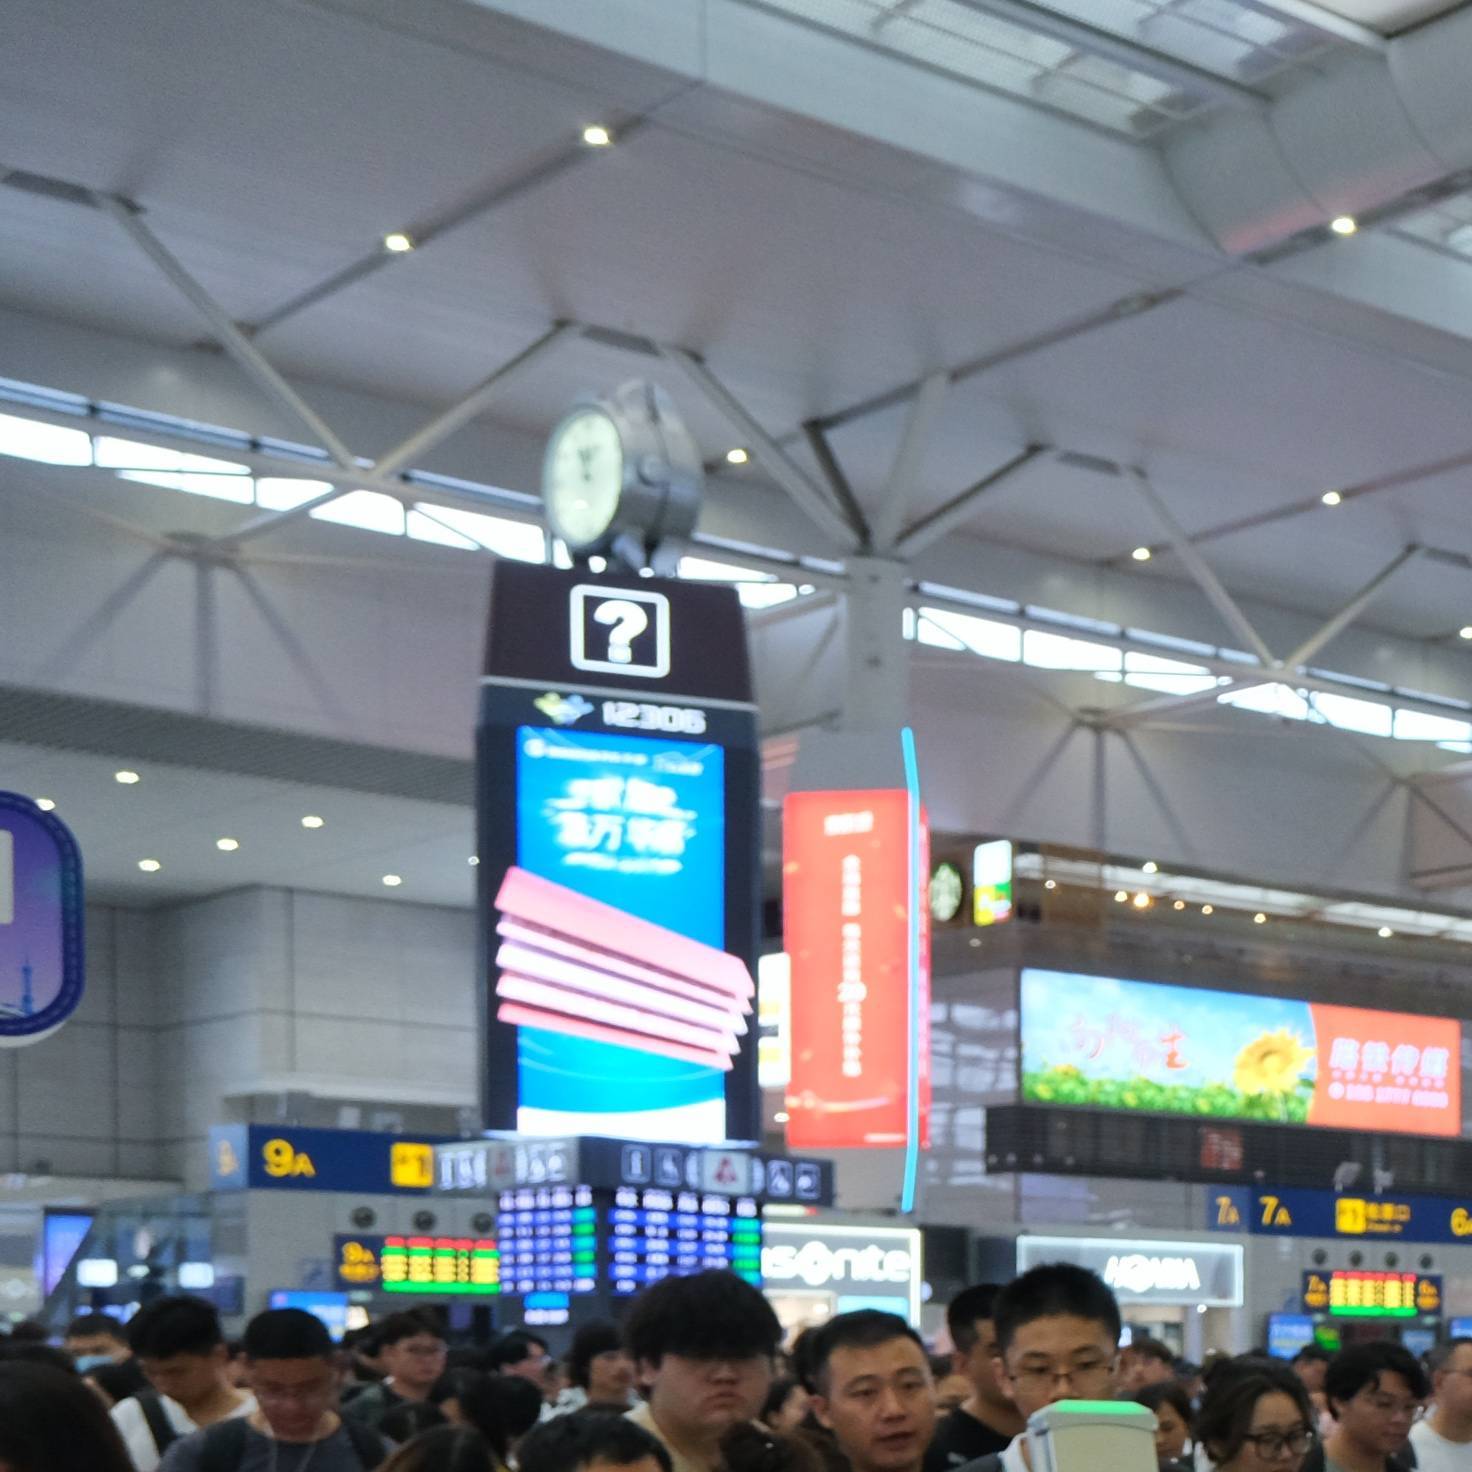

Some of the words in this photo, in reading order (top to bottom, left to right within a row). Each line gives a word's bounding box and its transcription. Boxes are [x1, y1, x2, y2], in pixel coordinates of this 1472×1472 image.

[602, 701, 707, 734] 12306
[263, 1138, 316, 1177] 9A
[1260, 1196, 1292, 1227] 7A
